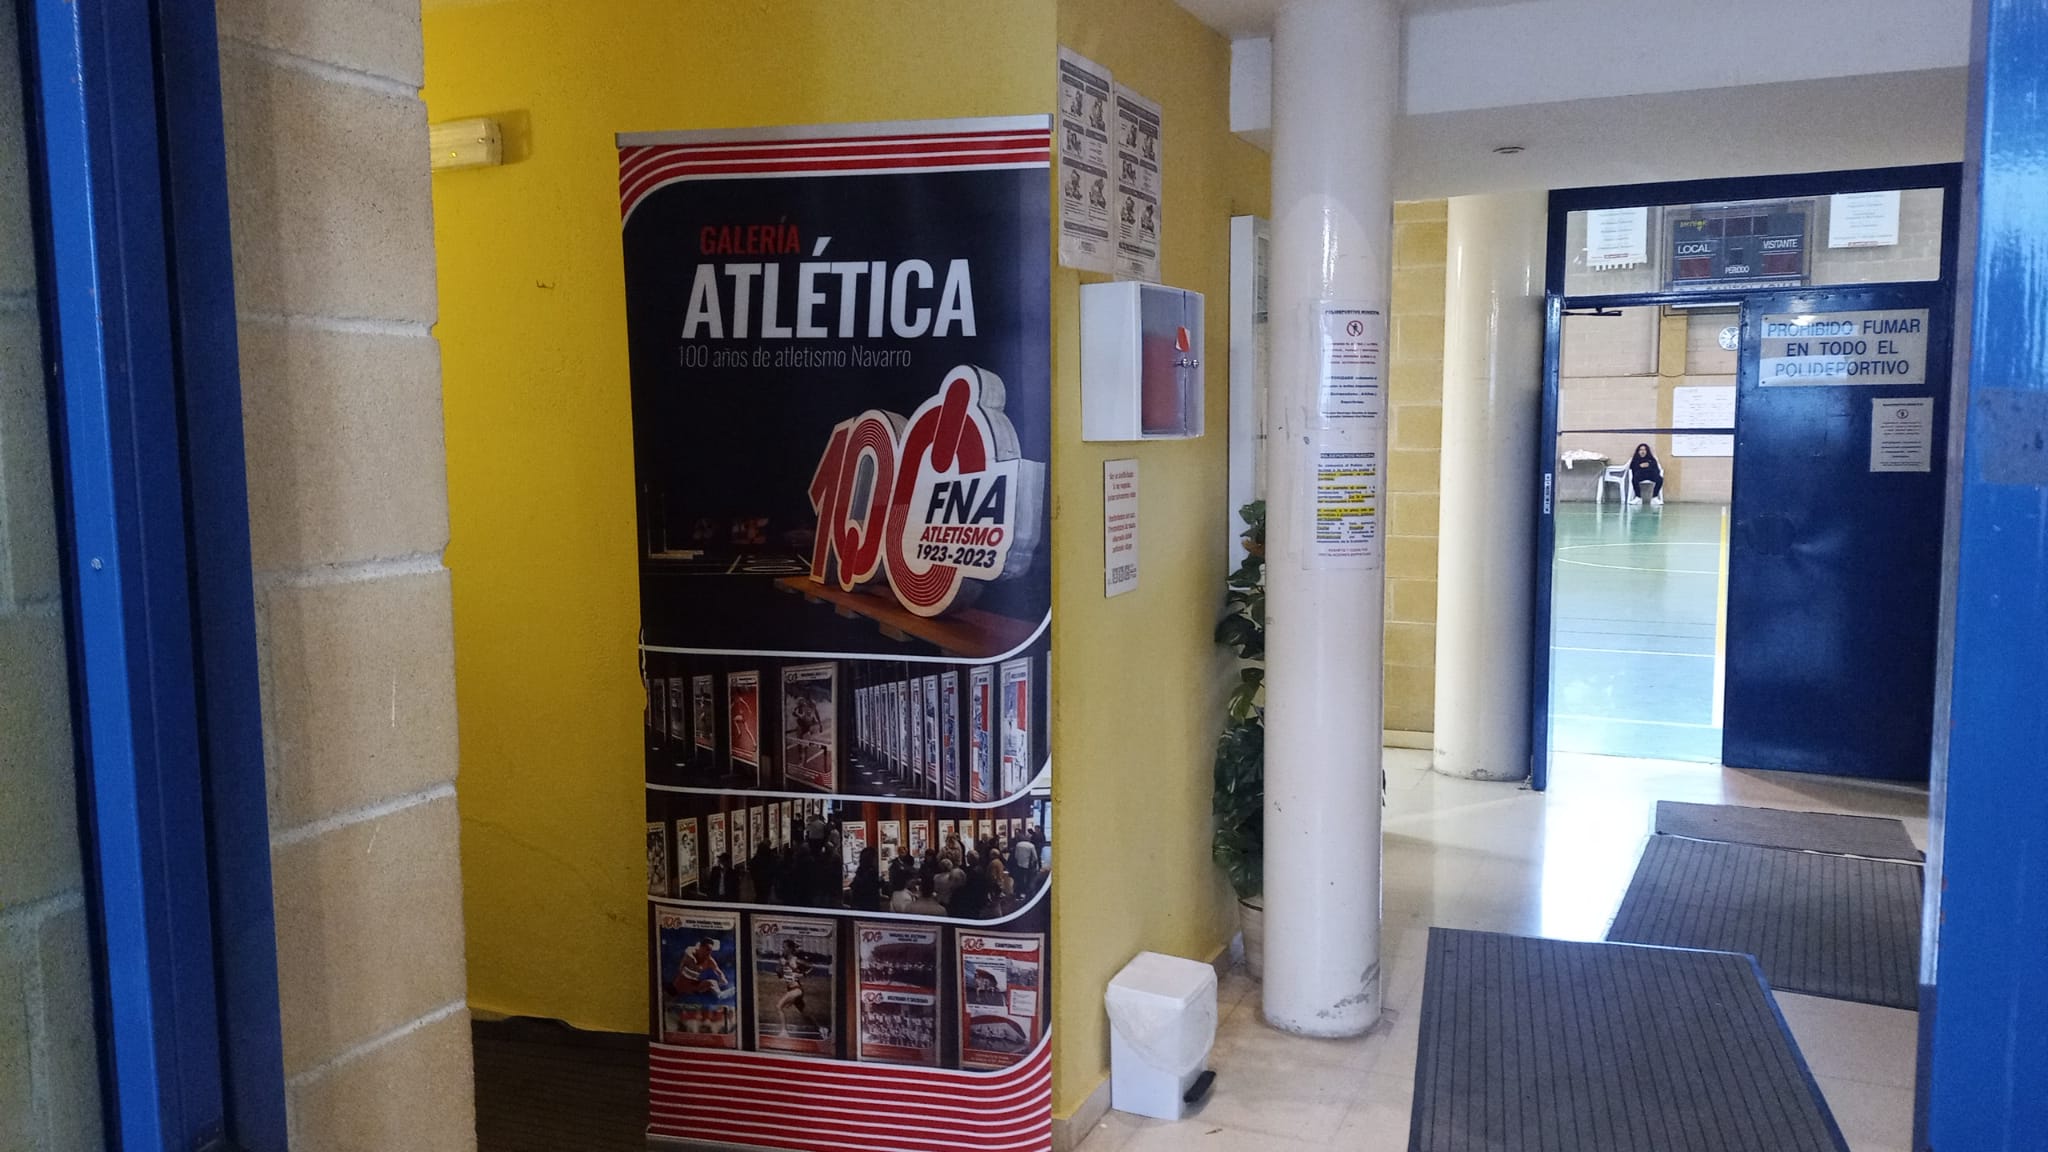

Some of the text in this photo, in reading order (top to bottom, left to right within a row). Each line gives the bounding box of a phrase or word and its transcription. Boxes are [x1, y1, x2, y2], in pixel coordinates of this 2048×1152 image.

[700, 215, 801, 256] GALERÍA
[1763, 239, 1798, 249] VISITANTE
[1677, 244, 1711, 254] LOCAL
[681, 236, 977, 340] ATLÉTICA
[1767, 318, 1921, 338] PROHIBIDO FUMAR
[678, 345, 912, 369] 100 años de atletismo Navarro
[1787, 340, 1899, 358] EN TODO EL
[1774, 360, 1911, 378] POLIDEPORTIVO
[925, 475, 1008, 525] FNA
[920, 525, 1005, 548] ATLETISMO
[916, 543, 998, 569] 1923-2023
